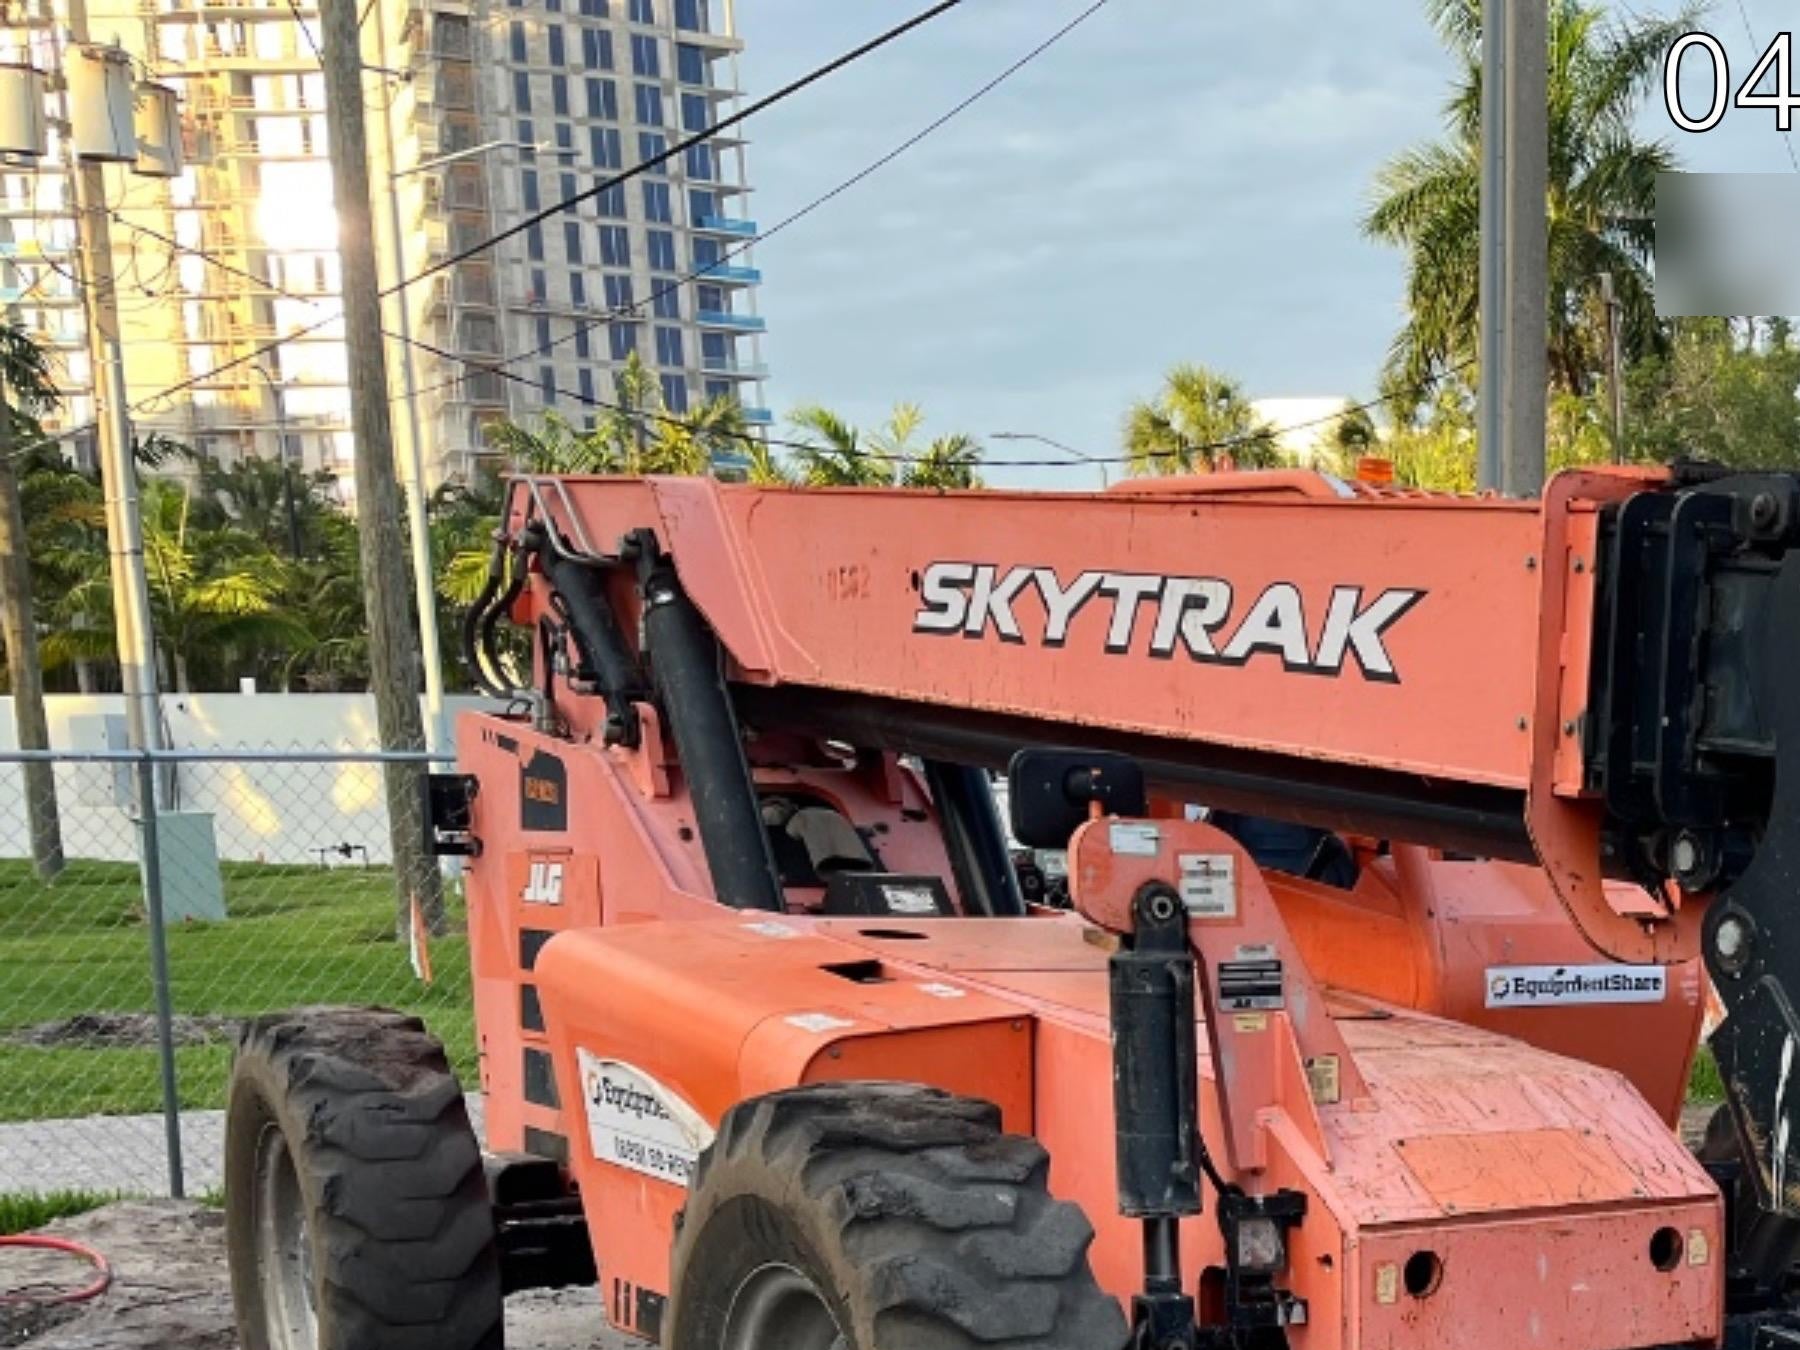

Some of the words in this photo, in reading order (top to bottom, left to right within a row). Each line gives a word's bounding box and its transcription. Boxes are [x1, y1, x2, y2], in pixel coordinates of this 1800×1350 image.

[912, 561, 1429, 684] SKYTRAK
[523, 862, 564, 905] JLG
[1512, 974, 1662, 998] EquipmentShare
